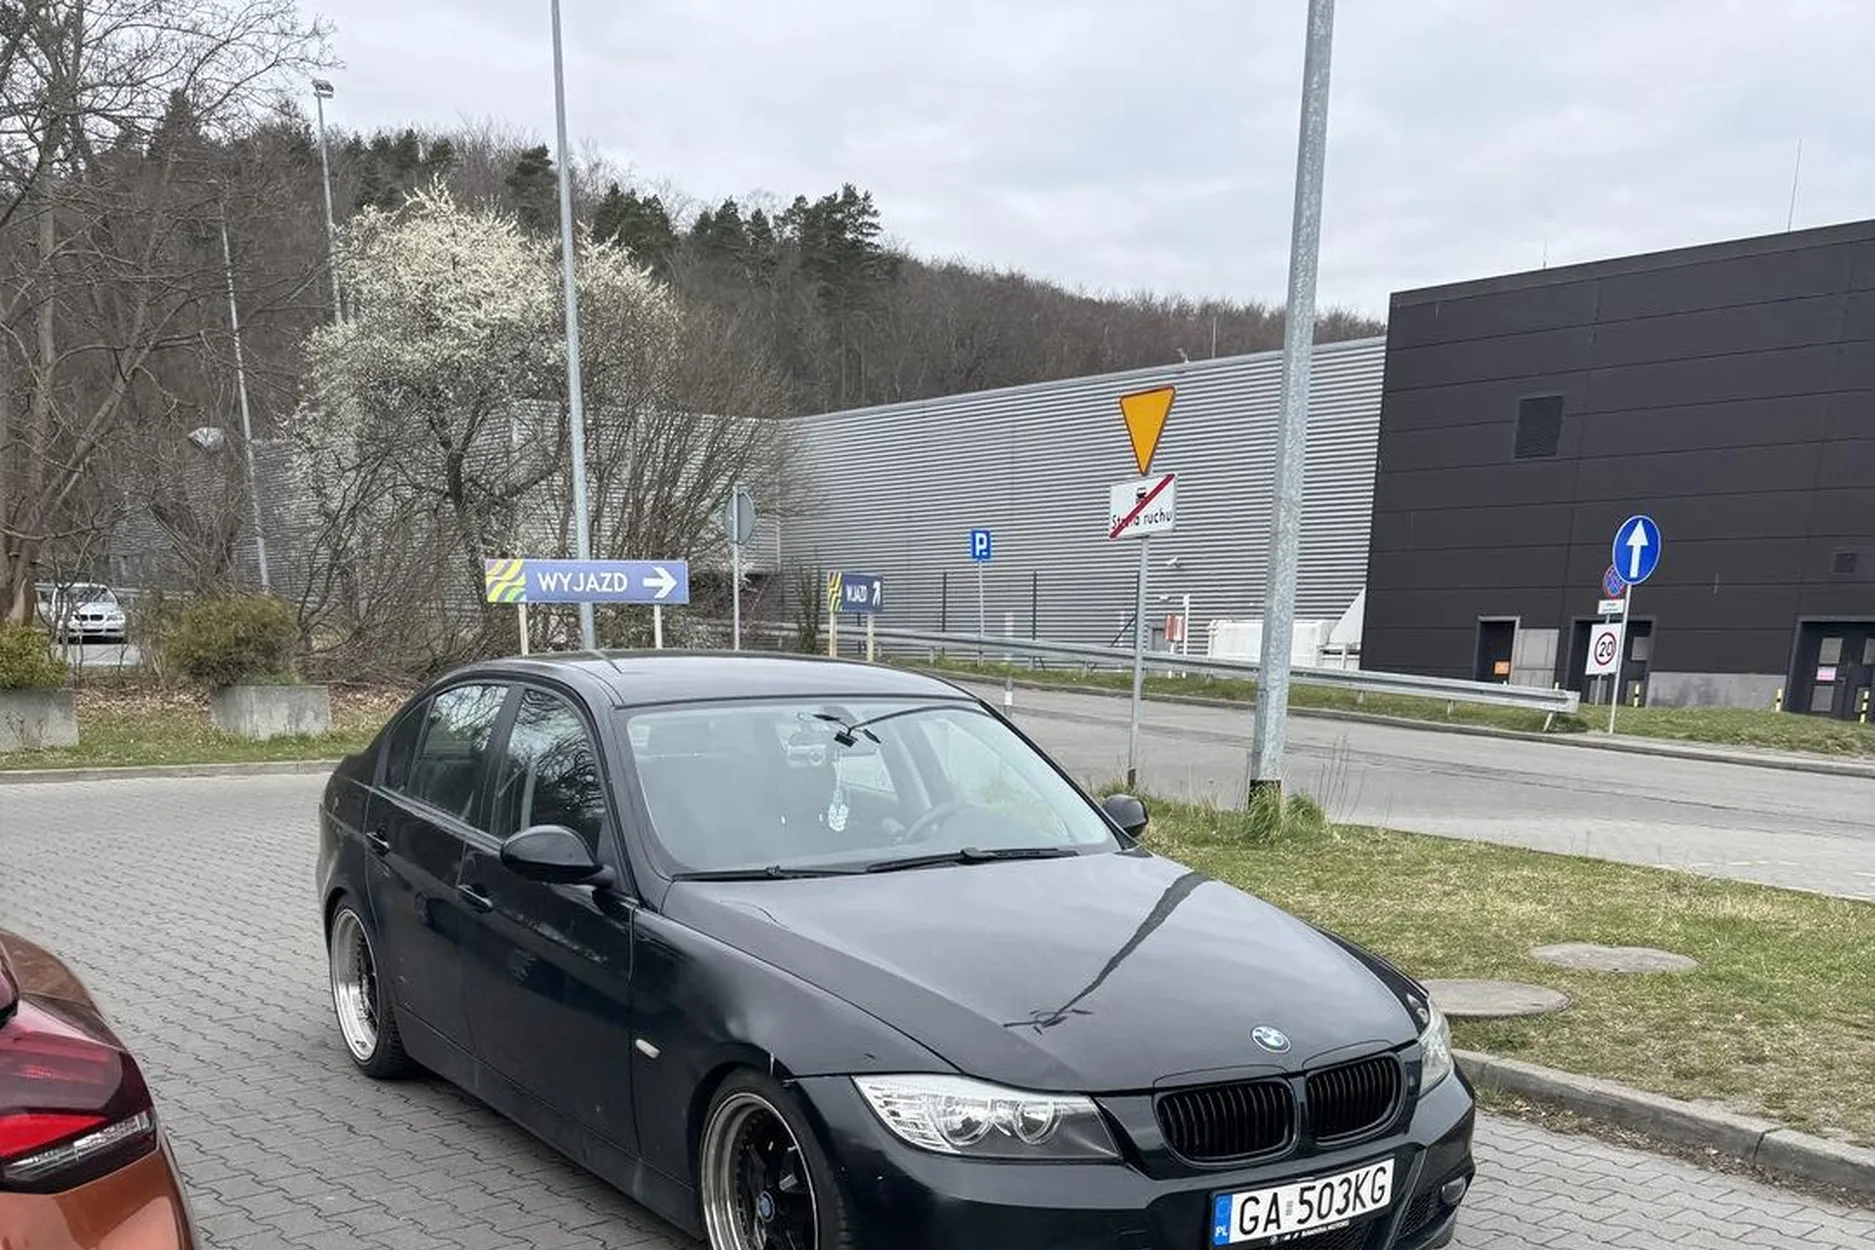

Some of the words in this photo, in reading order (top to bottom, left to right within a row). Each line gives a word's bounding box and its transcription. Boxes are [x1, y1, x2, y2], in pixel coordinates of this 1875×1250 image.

[1143, 508, 1173, 525] ruchu
[975, 533, 987, 556] P
[537, 571, 628, 592] WYJAZD
[1598, 641, 1614, 657] 20
[1239, 1192, 1281, 1236] GA
[1296, 1166, 1386, 1225] 503KG
[1214, 1225, 1228, 1237] PL
